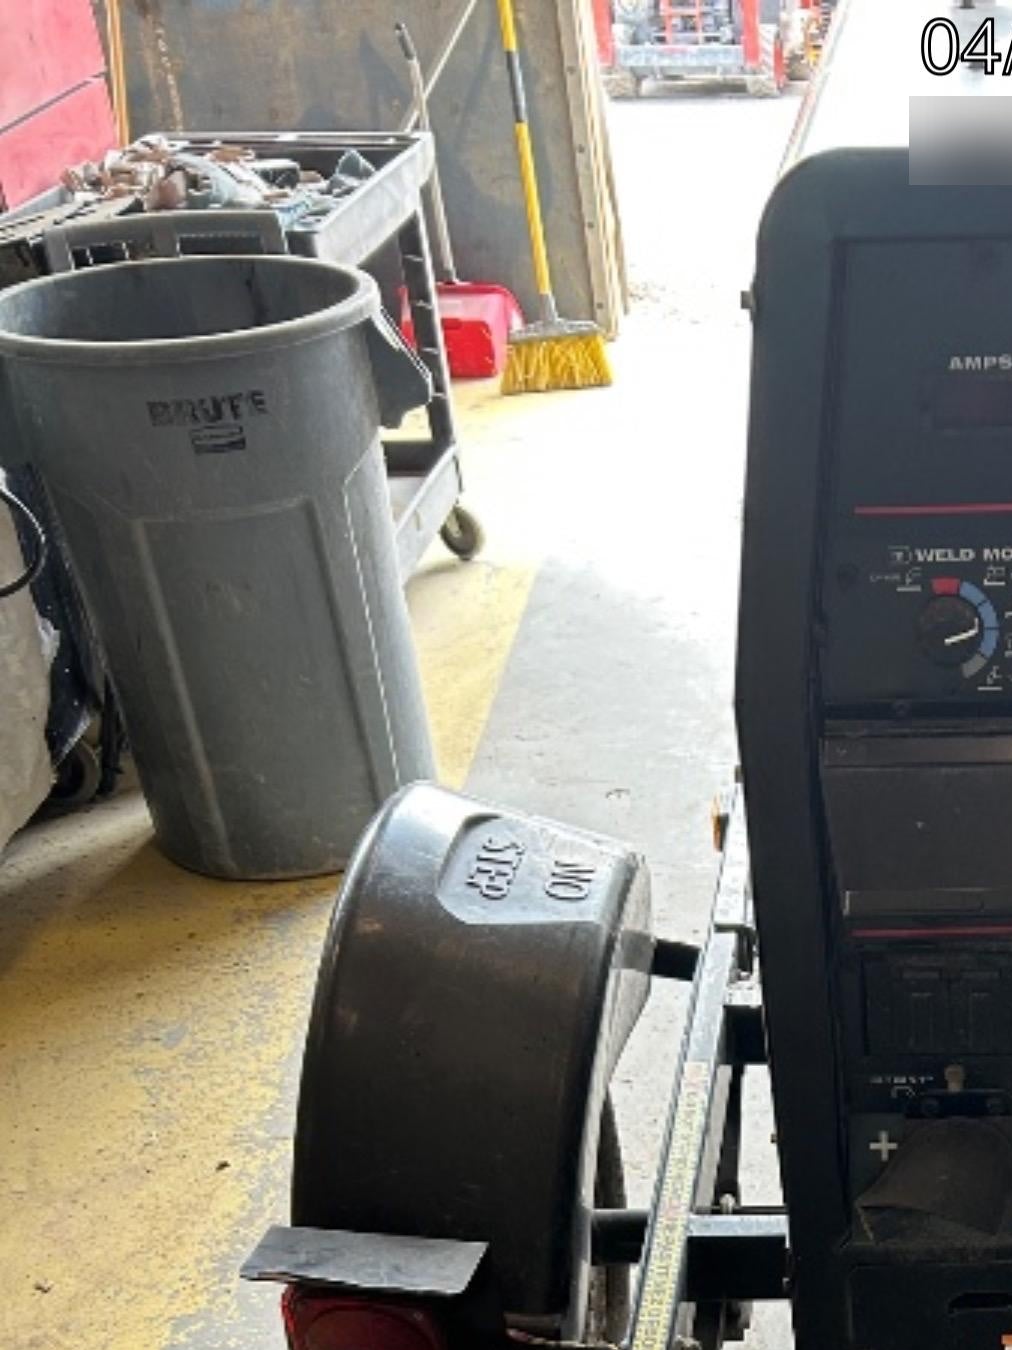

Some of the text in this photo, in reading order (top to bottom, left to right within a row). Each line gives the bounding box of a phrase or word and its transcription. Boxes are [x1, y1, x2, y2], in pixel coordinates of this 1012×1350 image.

[914, 547, 975, 563] WELD
[466, 837, 525, 900] STEP
[545, 860, 595, 900] NO
